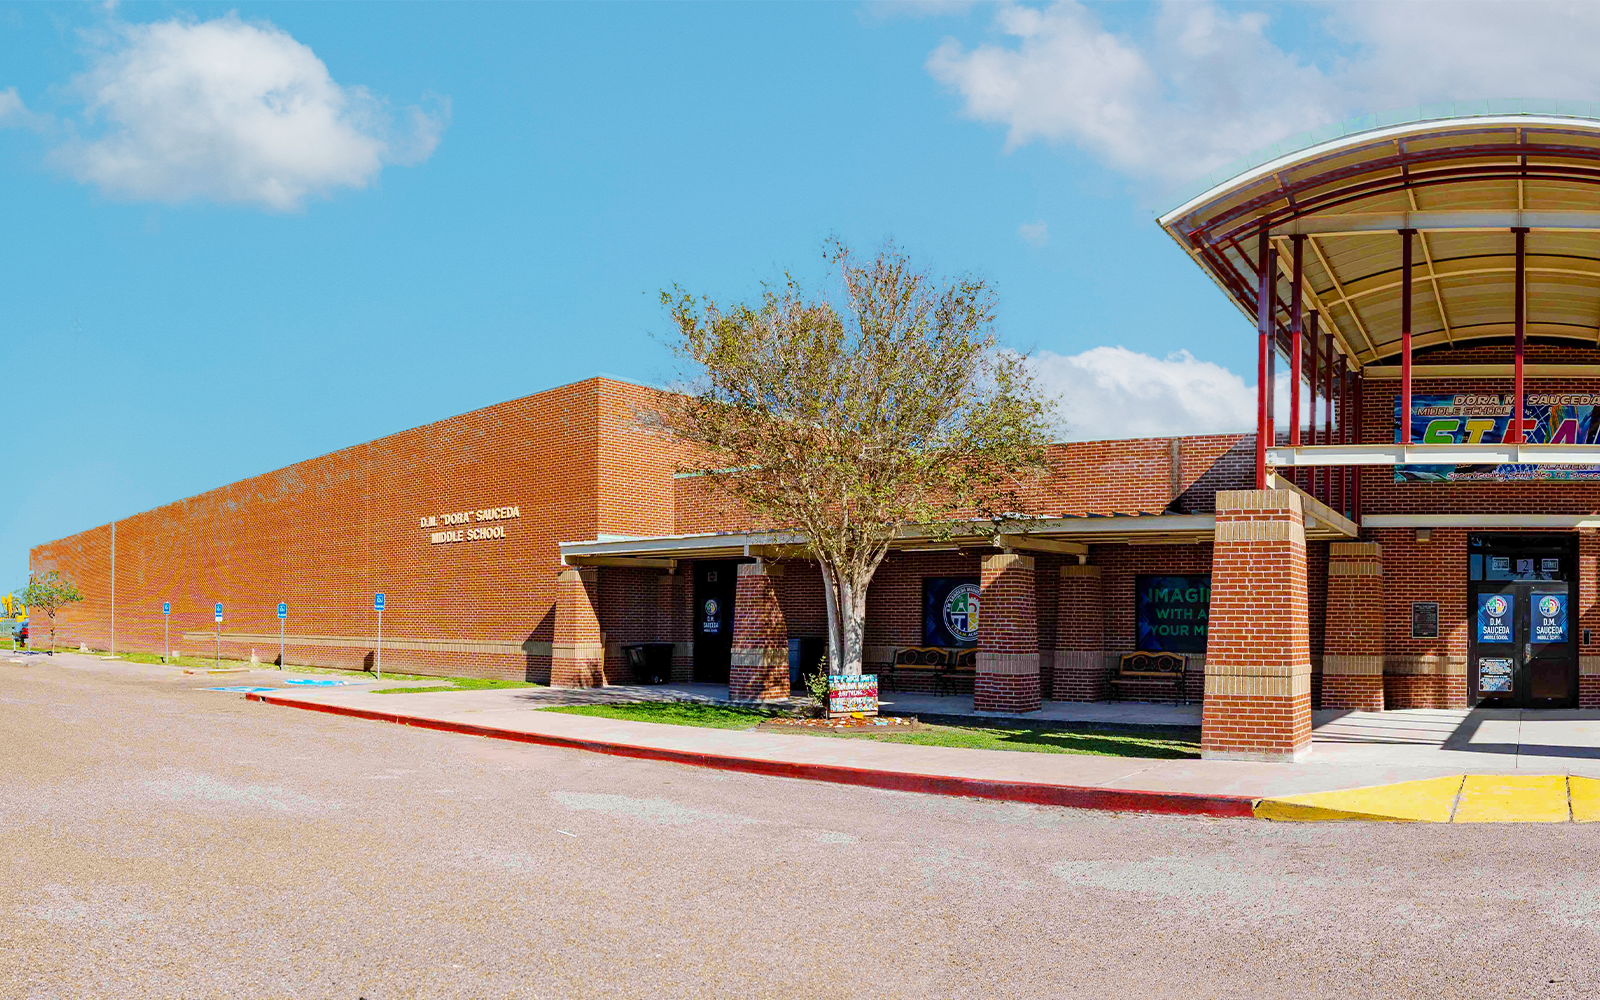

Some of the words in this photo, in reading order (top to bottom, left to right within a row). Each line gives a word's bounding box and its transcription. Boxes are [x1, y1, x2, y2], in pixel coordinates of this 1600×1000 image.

[1453, 394, 1500, 406] DORA
[1416, 406, 1461, 416] MIDDLE
[1463, 406, 1512, 416] SCHOOL
[476, 506, 519, 521] SAUCEDA
[431, 530, 464, 544] MIDDLE
[466, 526, 506, 541] SCHOOL
[1522, 560, 1529, 571] 2
[1156, 608, 1193, 619] WITH
[1149, 625, 1189, 636] YOUR
[1483, 626, 1510, 634] SAUCEDA
[1536, 626, 1563, 634] SAUCEDA
